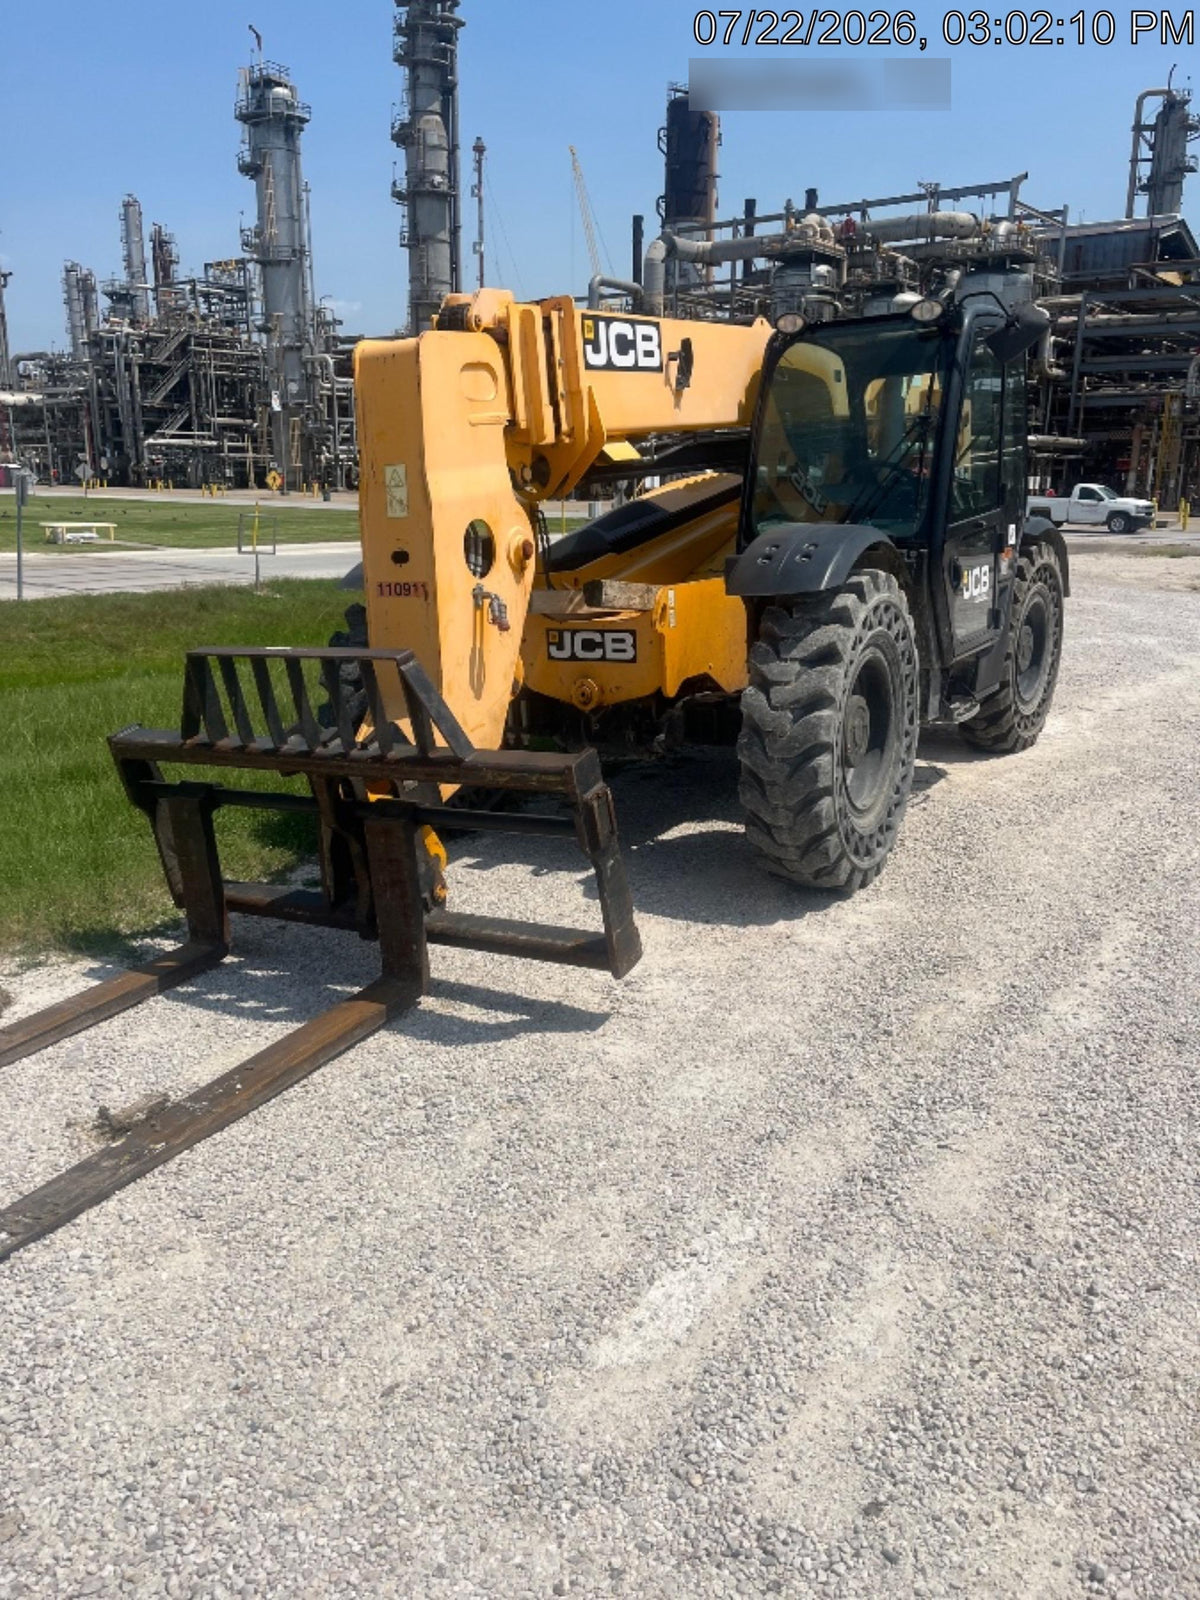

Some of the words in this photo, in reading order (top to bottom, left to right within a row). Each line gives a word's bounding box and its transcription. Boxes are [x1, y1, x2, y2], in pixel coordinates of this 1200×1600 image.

[584, 320, 661, 367] JCB
[962, 565, 990, 600] JCB
[548, 630, 636, 660] JCB
